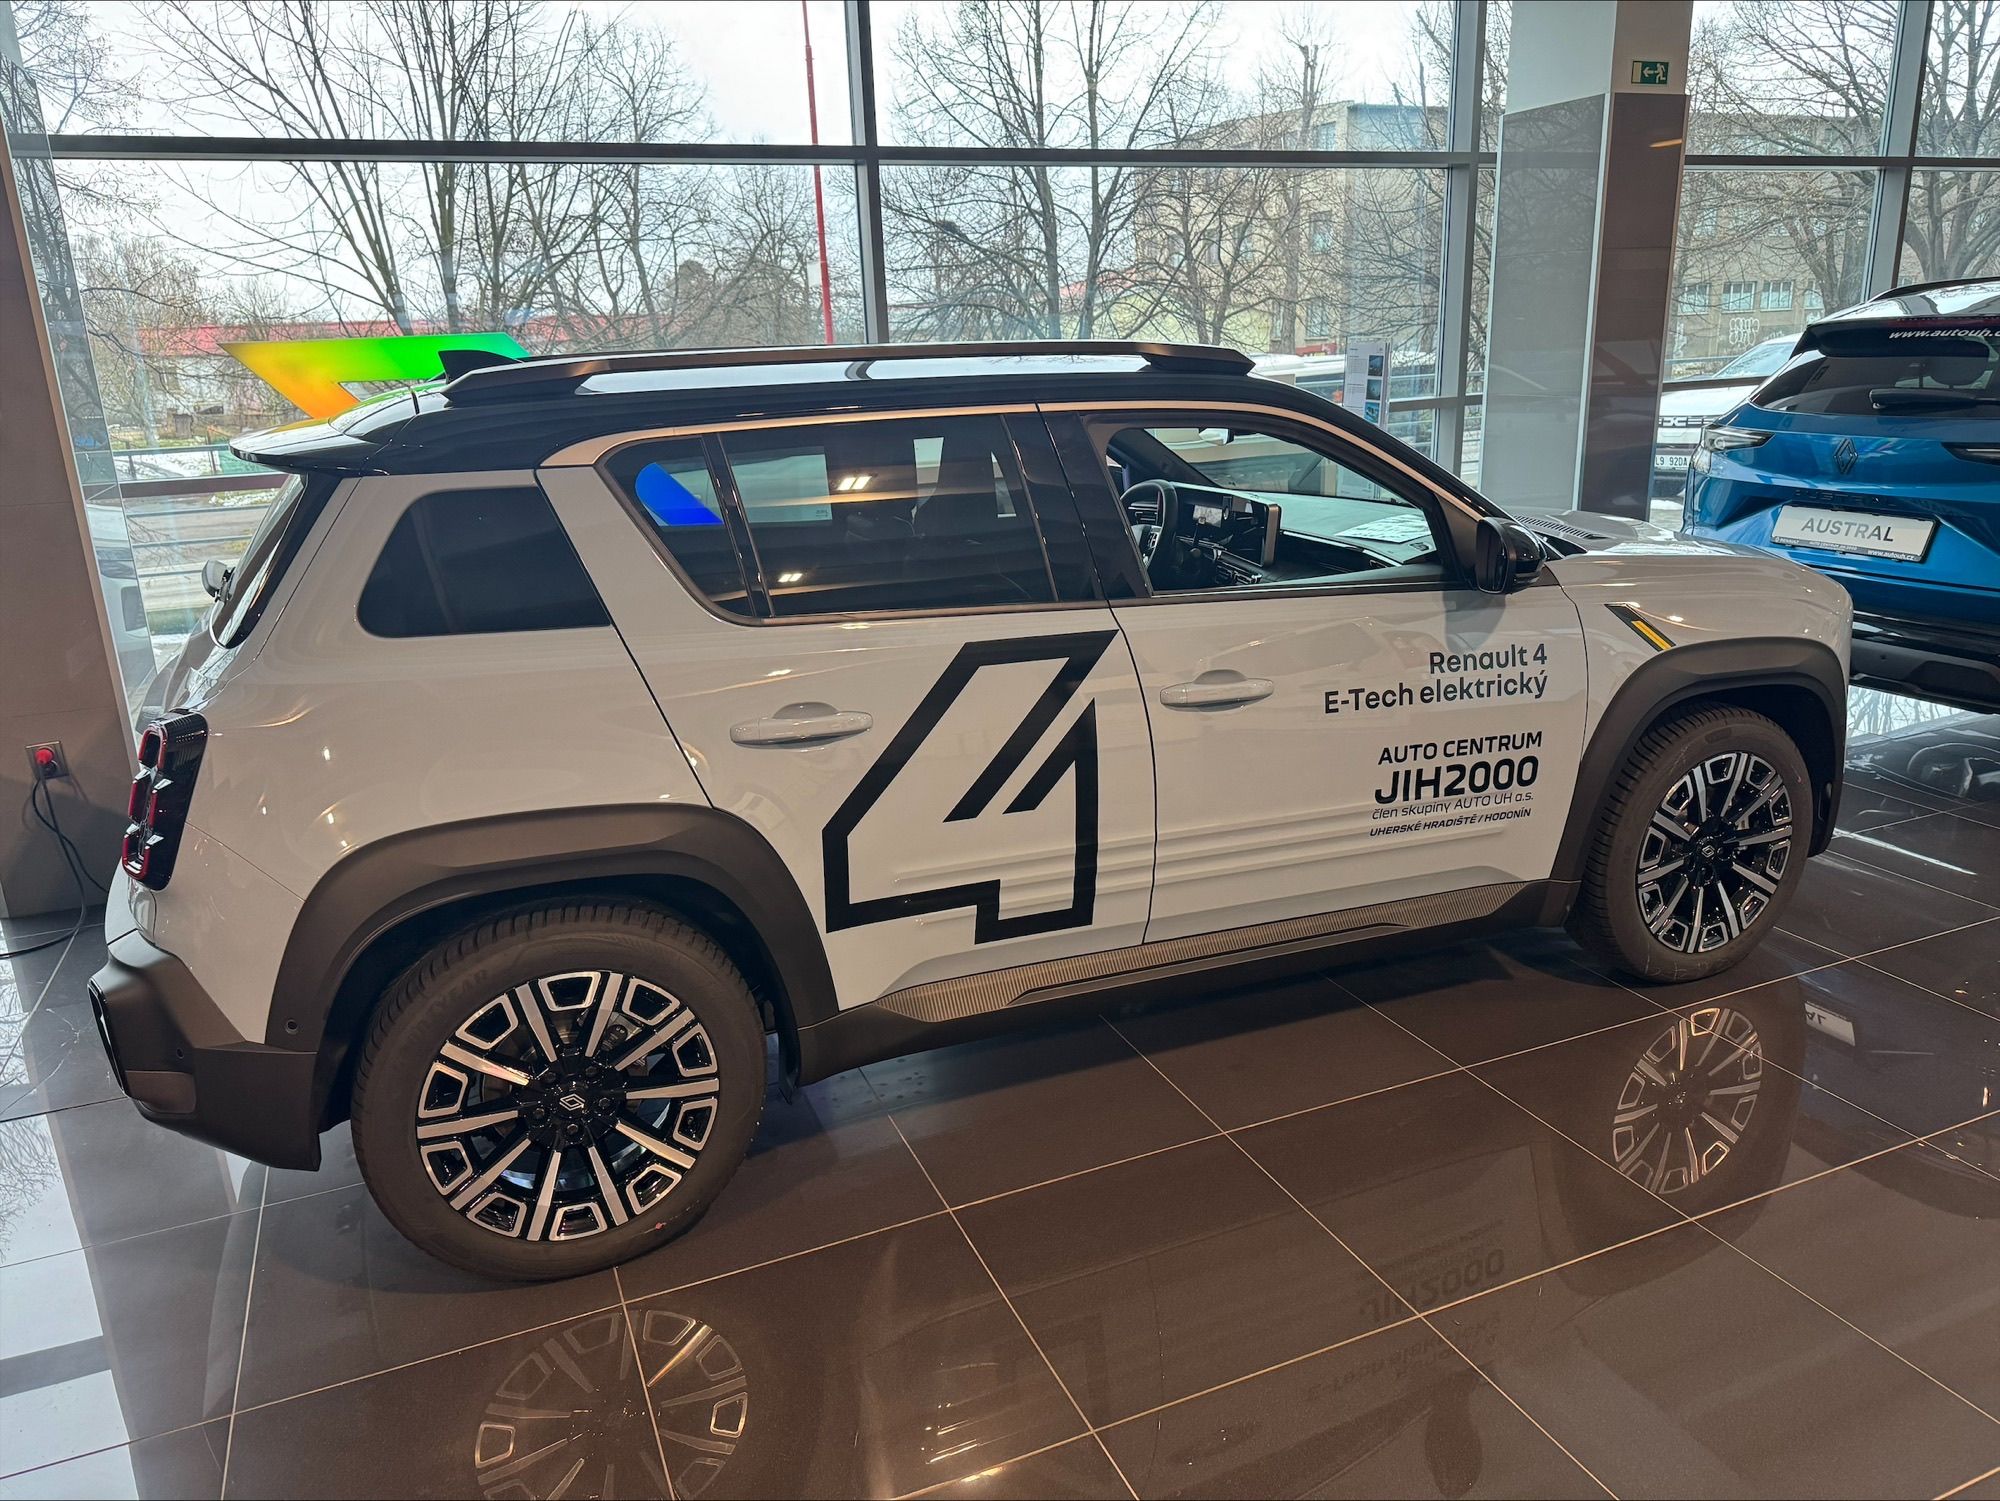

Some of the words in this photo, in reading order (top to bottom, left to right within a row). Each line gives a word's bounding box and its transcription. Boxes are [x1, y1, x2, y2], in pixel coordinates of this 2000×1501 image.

[1800, 517, 1894, 542] AUSTRAL
[1429, 644, 1528, 674] Renault
[1533, 643, 1548, 665] 4
[1324, 682, 1414, 714] E-Tech
[1420, 670, 1548, 702] elektrický
[1377, 742, 1438, 766] AUTO
[1443, 731, 1543, 758] CENTRUM
[1374, 755, 1539, 804] JIH2000
[1371, 807, 1398, 820] člen
[1401, 801, 1451, 817] skupiny
[1454, 795, 1491, 810] AUTO
[1494, 792, 1513, 805] UH
[1514, 791, 1534, 802] a.s.
[1369, 821, 1422, 837] UHERSKÉ
[1422, 813, 1477, 830] HRADIŠTĚ
[1477, 814, 1484, 823] /
[1484, 807, 1532, 822] HODONÍN
